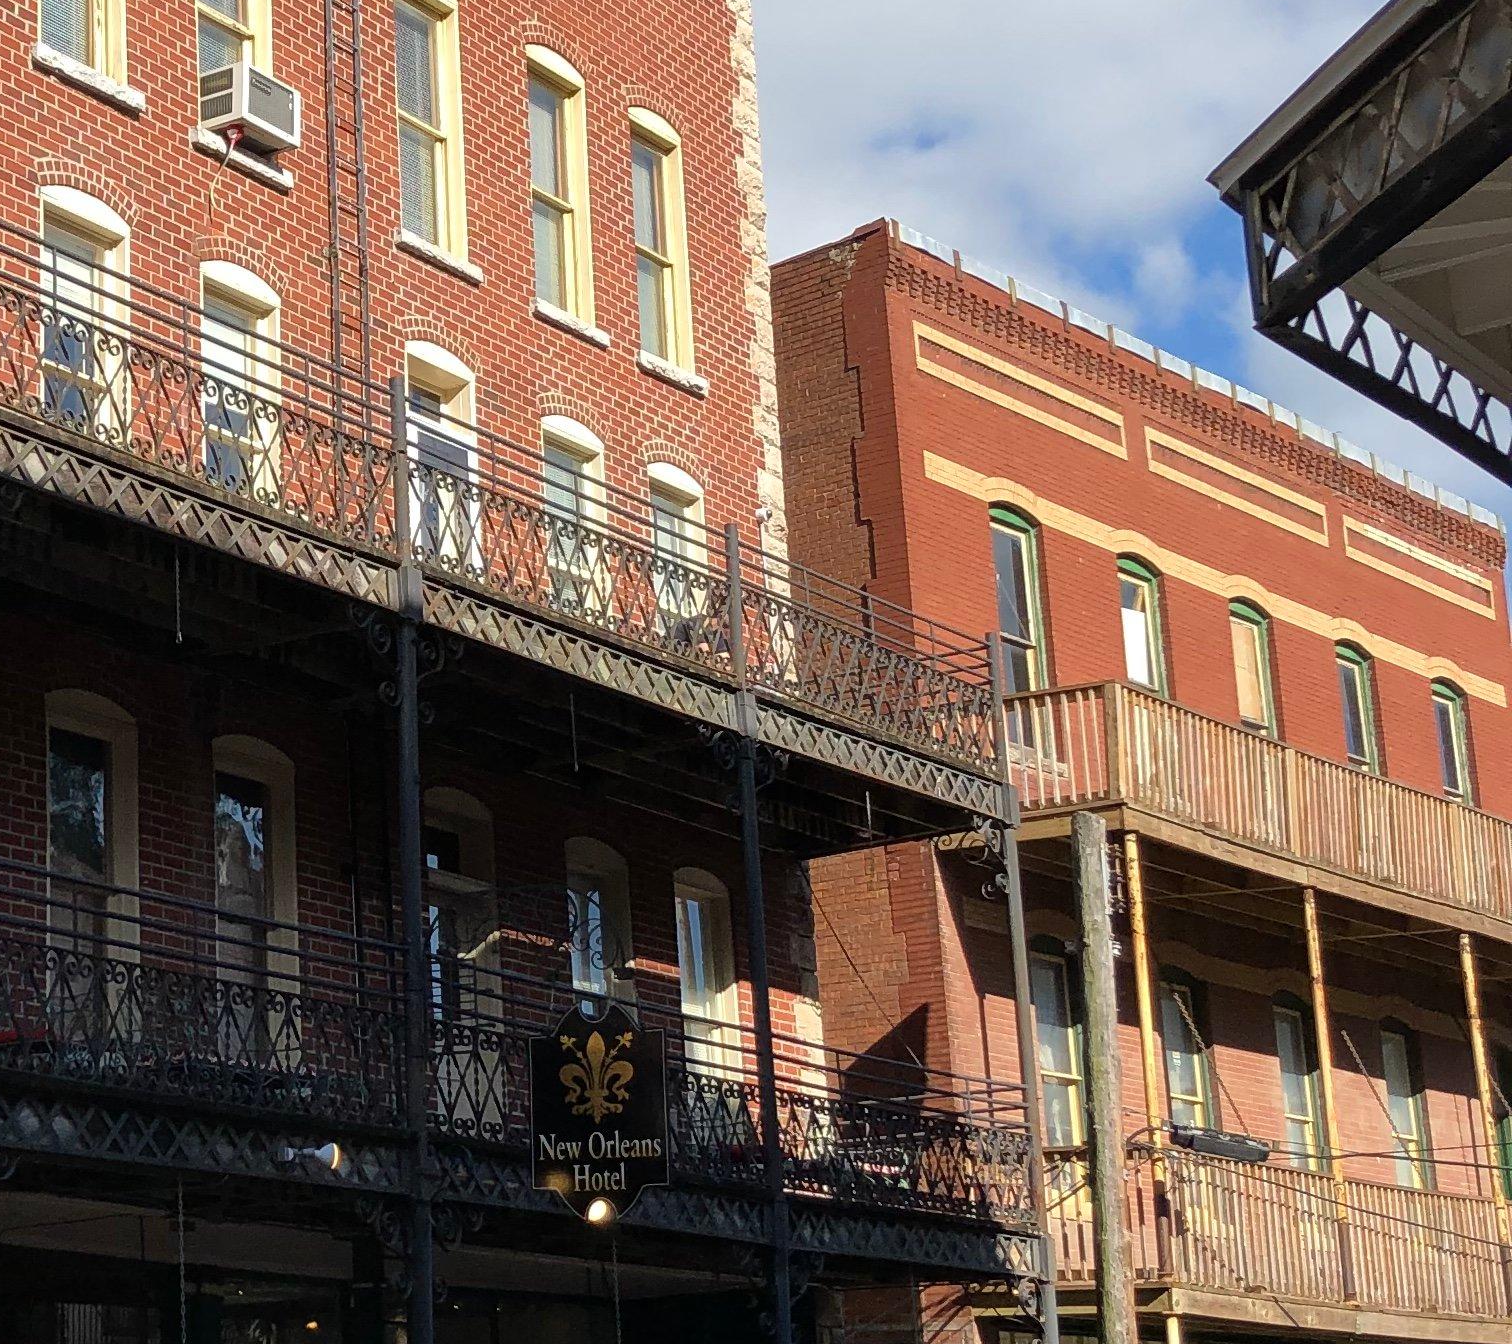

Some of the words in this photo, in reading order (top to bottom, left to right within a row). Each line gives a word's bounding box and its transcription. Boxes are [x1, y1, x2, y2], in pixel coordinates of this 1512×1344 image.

[538, 1133, 582, 1161] New
[588, 1129, 662, 1159] Orleans
[573, 1161, 627, 1192] Hotel
